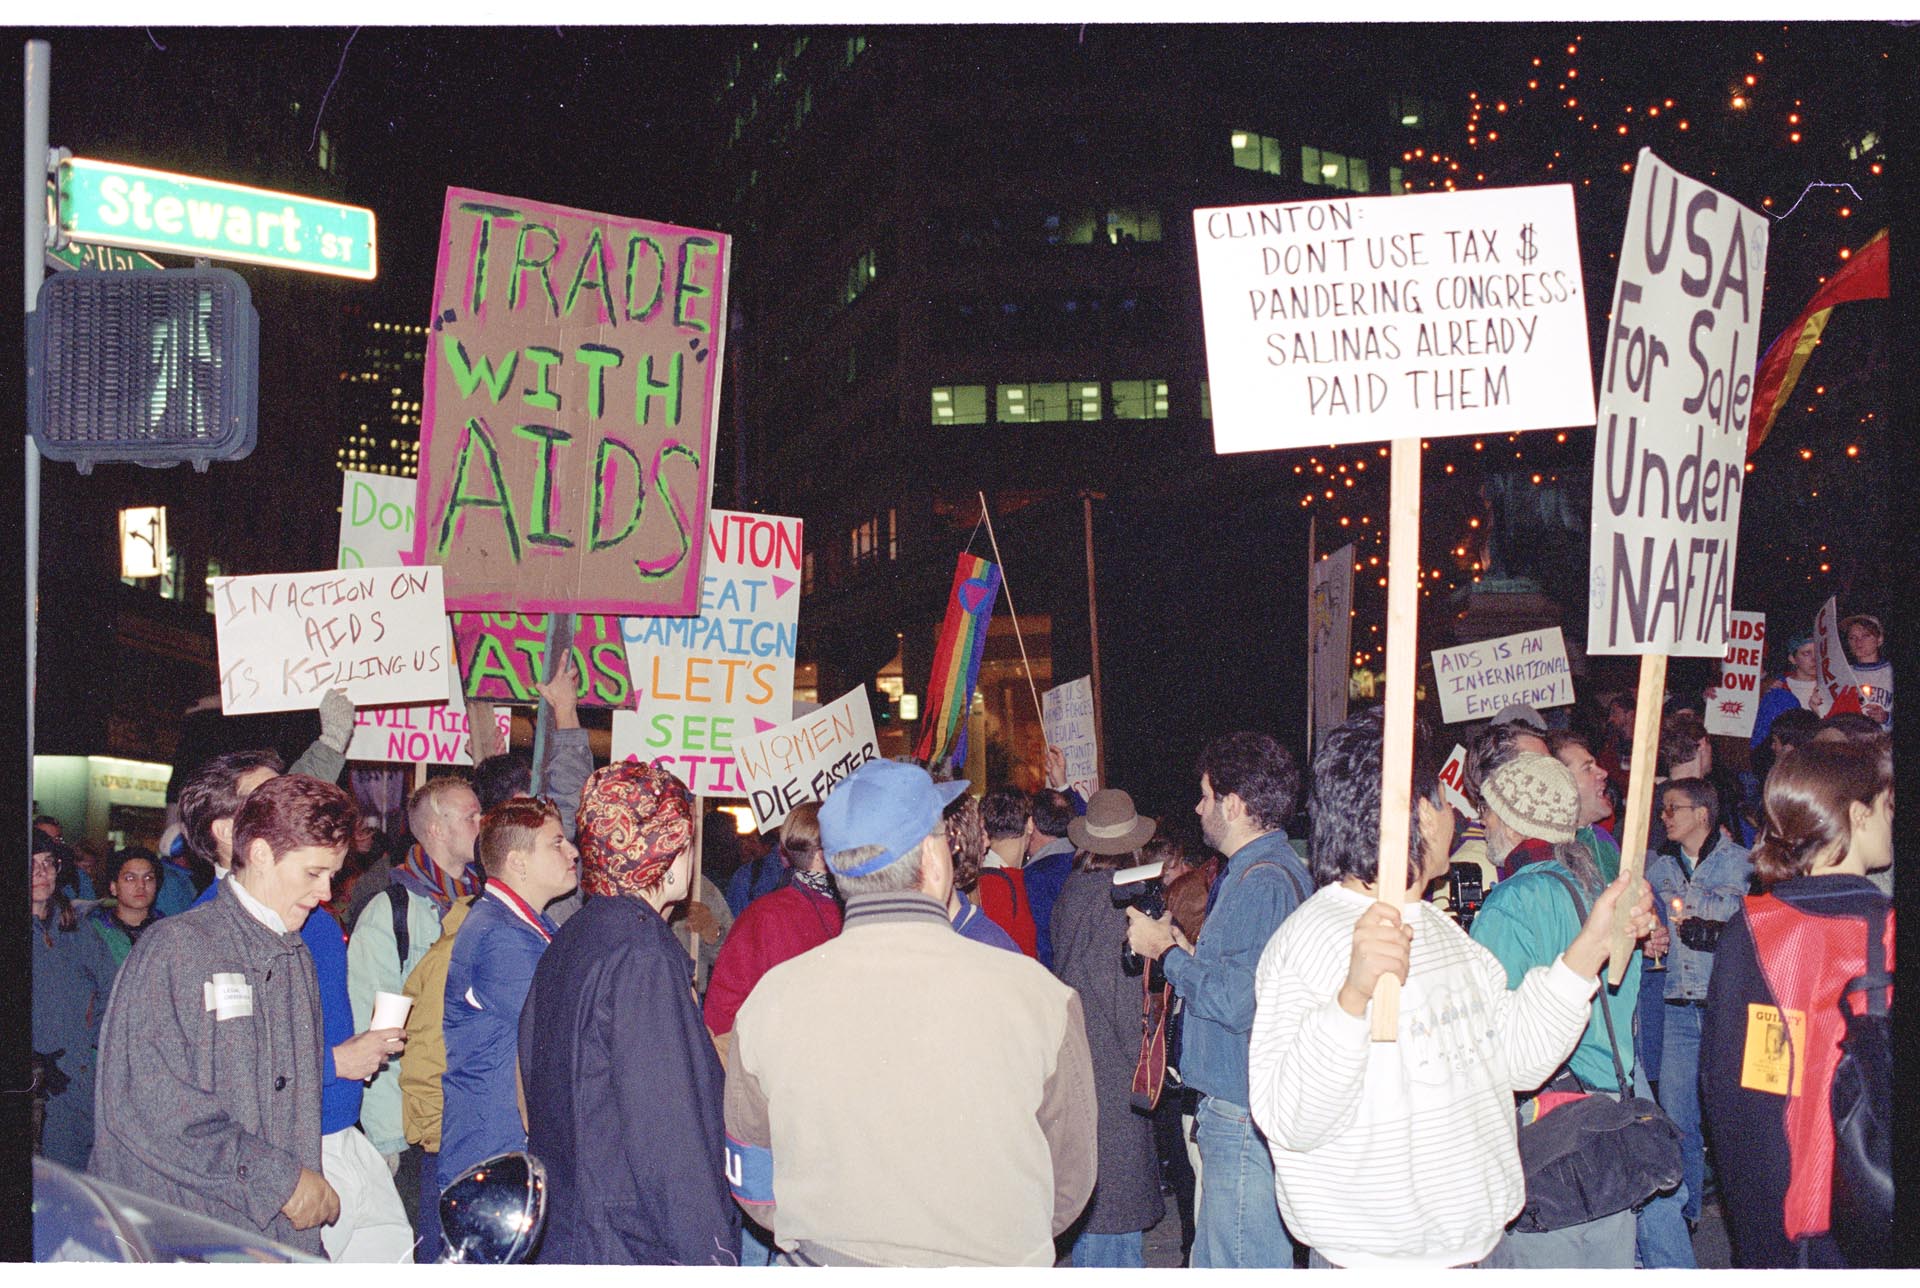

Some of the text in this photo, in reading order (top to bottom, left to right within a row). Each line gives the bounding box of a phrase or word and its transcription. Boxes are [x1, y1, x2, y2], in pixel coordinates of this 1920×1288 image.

[99, 174, 353, 262] Stewart ST
[1208, 203, 1365, 239] CLINTON:
[460, 202, 719, 333] TRADE
[1262, 222, 1539, 276] DON'T USE TAX $
[1645, 165, 1749, 323] USA
[1249, 280, 1424, 320] PANDERING
[1266, 315, 1538, 366] SALINAS ALREADY
[1607, 280, 1751, 435] For Sale
[1307, 365, 1511, 416] PAID THEM
[1605, 413, 1741, 525] Under
[438, 417, 700, 583] AIDS
[390, 571, 429, 600] ON
[701, 576, 768, 613] EAT
[1609, 532, 1729, 648] NAFTA
[304, 610, 386, 657] AIDS
[619, 616, 797, 659] CAMPAIGN
[1440, 636, 1543, 673] AIDS IS AN
[1730, 620, 1765, 642] IDS
[221, 646, 442, 709] IS KILLING US
[651, 655, 777, 705] LET'S
[1724, 647, 1760, 667] URE
[1723, 672, 1757, 692] OW
[353, 706, 418, 730] IVIL
[645, 713, 736, 751] SEE
[741, 703, 855, 781] WOMEN
[387, 731, 462, 763] NOW
[752, 776, 810, 824] DIE
